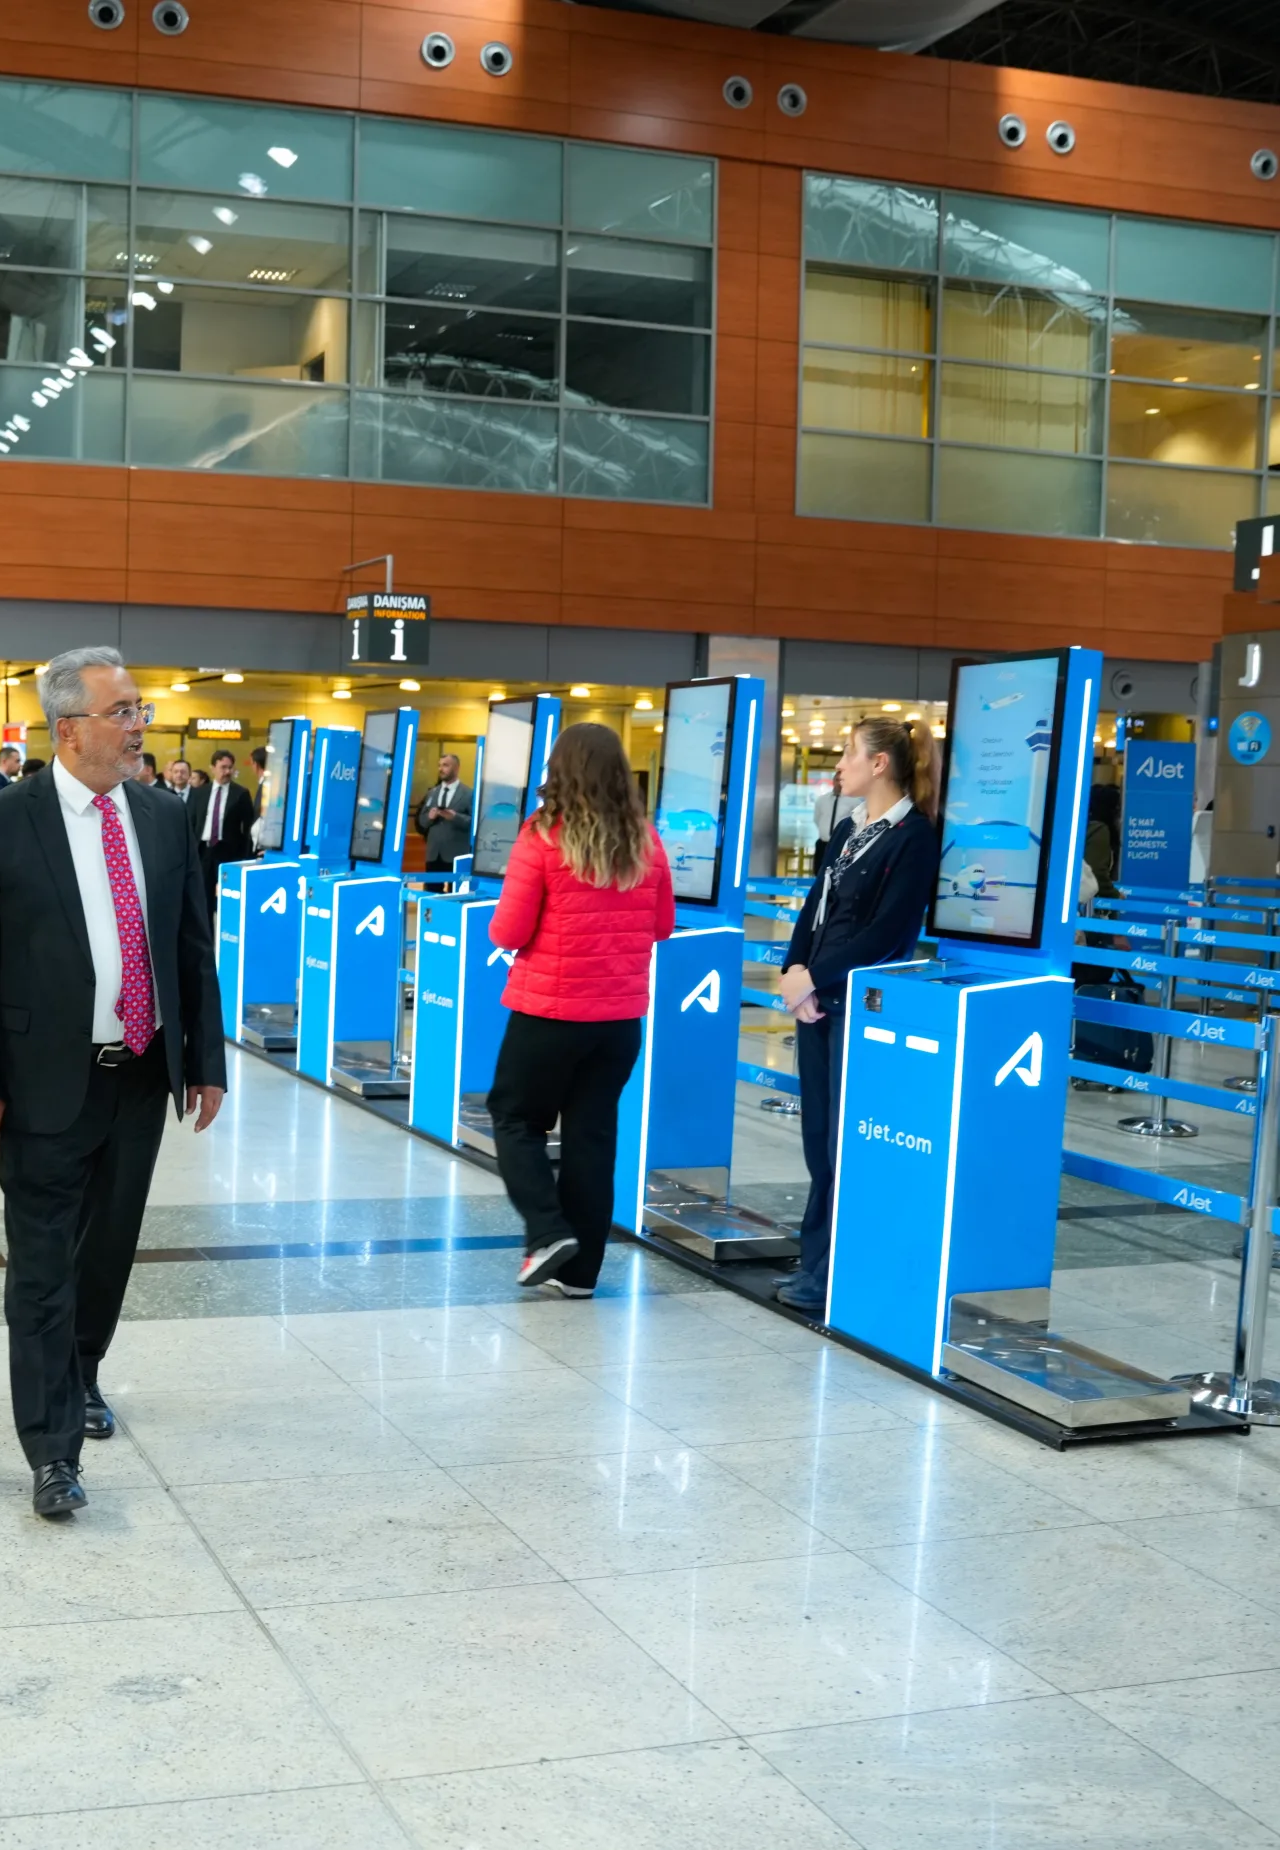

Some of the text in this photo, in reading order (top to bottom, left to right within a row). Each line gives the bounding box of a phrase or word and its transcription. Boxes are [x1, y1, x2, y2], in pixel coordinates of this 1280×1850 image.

[373, 594, 426, 611] DANIŞMA
[374, 609, 426, 620] INFORMATION
[197, 718, 241, 731] DANIŞMA
[330, 760, 356, 781] AJet
[1136, 755, 1184, 779] AJet
[1128, 840, 1168, 849] DOMESTIC
[1128, 851, 1159, 860] FLIGHTS
[1193, 931, 1216, 944] AJet
[1131, 956, 1158, 972] AJet
[1244, 971, 1276, 988] AJet
[422, 989, 454, 1008] ajet.com
[1186, 1019, 1227, 1041] AJet
[995, 1031, 1043, 1087] A
[1123, 1075, 1150, 1092] AJet
[858, 1117, 933, 1155] ajet.com
[1173, 1187, 1213, 1213] AJet
